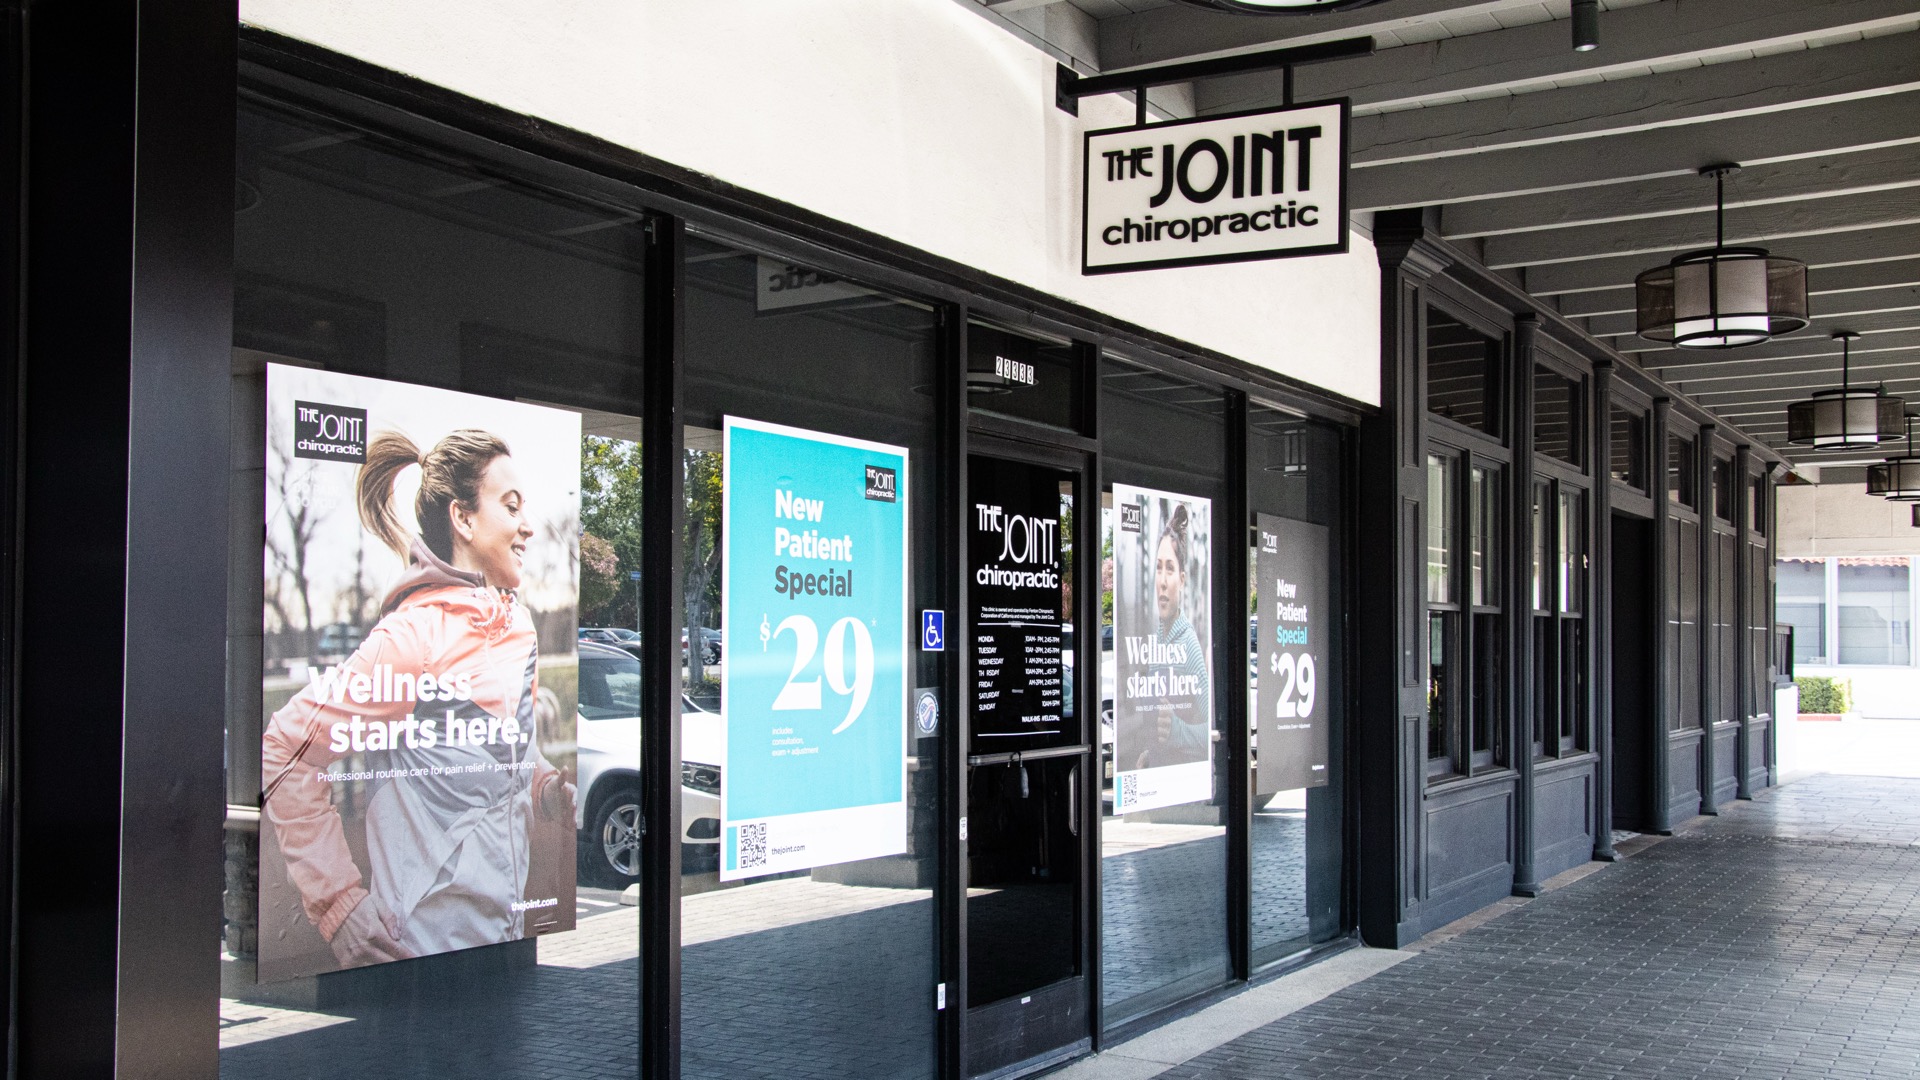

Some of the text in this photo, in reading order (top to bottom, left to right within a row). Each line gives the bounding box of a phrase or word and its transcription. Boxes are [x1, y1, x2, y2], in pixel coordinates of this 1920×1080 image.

[1102, 125, 1322, 208] THE JOINT
[1102, 200, 1319, 246] chiropractic
[298, 407, 363, 442] THE JOINT
[297, 439, 363, 456] chiropractic
[775, 489, 824, 522] New
[866, 488, 895, 498] chiropractic
[775, 527, 853, 562] Patient
[976, 503, 1057, 565] THE JOINT
[774, 565, 852, 600] Special
[976, 564, 1058, 590] chiropractic
[1277, 579, 1296, 598] New
[1277, 602, 1307, 622] Patient
[1125, 634, 1187, 665] Wellness
[1277, 625, 1307, 647] Special
[308, 663, 472, 705] Wellness
[979, 691, 1000, 699] SATURDAY
[1126, 666, 1202, 699] starts here.
[979, 703, 996, 711] SUNDAY
[329, 709, 528, 753] starts here.
[317, 768, 374, 782] Professional
[376, 767, 408, 779] routine
[409, 768, 429, 777] care
[430, 765, 444, 776] for
[445, 764, 463, 776] pain
[465, 762, 487, 773] relief
[495, 760, 538, 772] prevention.
[771, 845, 806, 856] thejoint.com
[511, 898, 558, 911] thejoint.com
